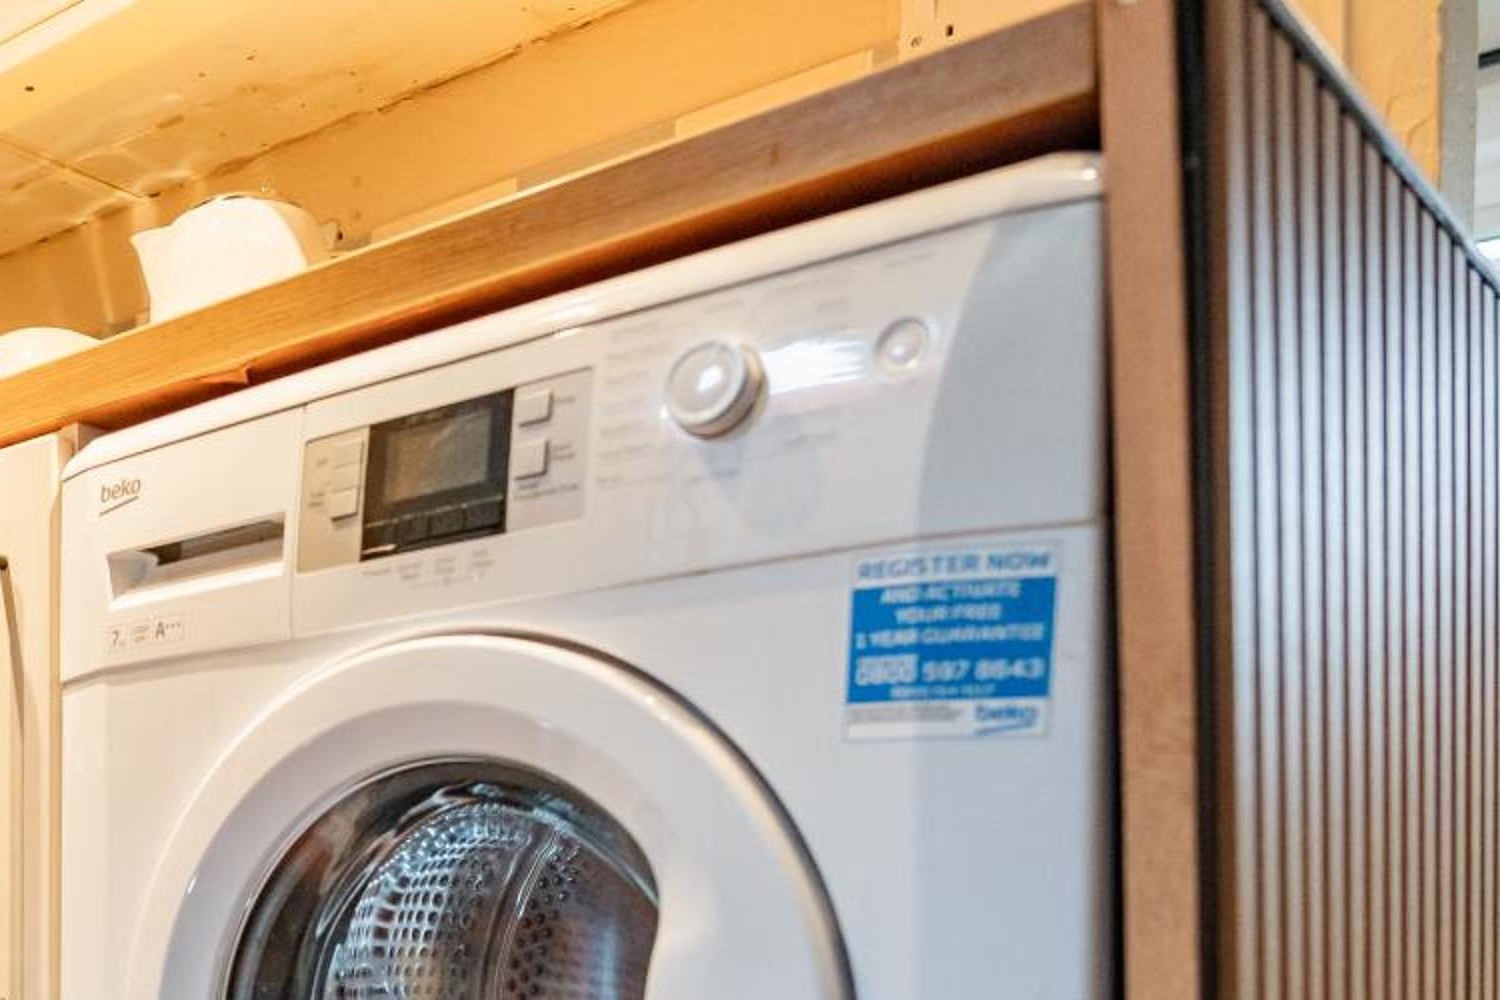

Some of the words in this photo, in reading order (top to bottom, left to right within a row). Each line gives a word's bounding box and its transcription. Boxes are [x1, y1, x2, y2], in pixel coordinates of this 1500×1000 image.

[100, 477, 142, 504] beko
[857, 554, 981, 580] REGISTER
[986, 550, 1050, 572] NOW
